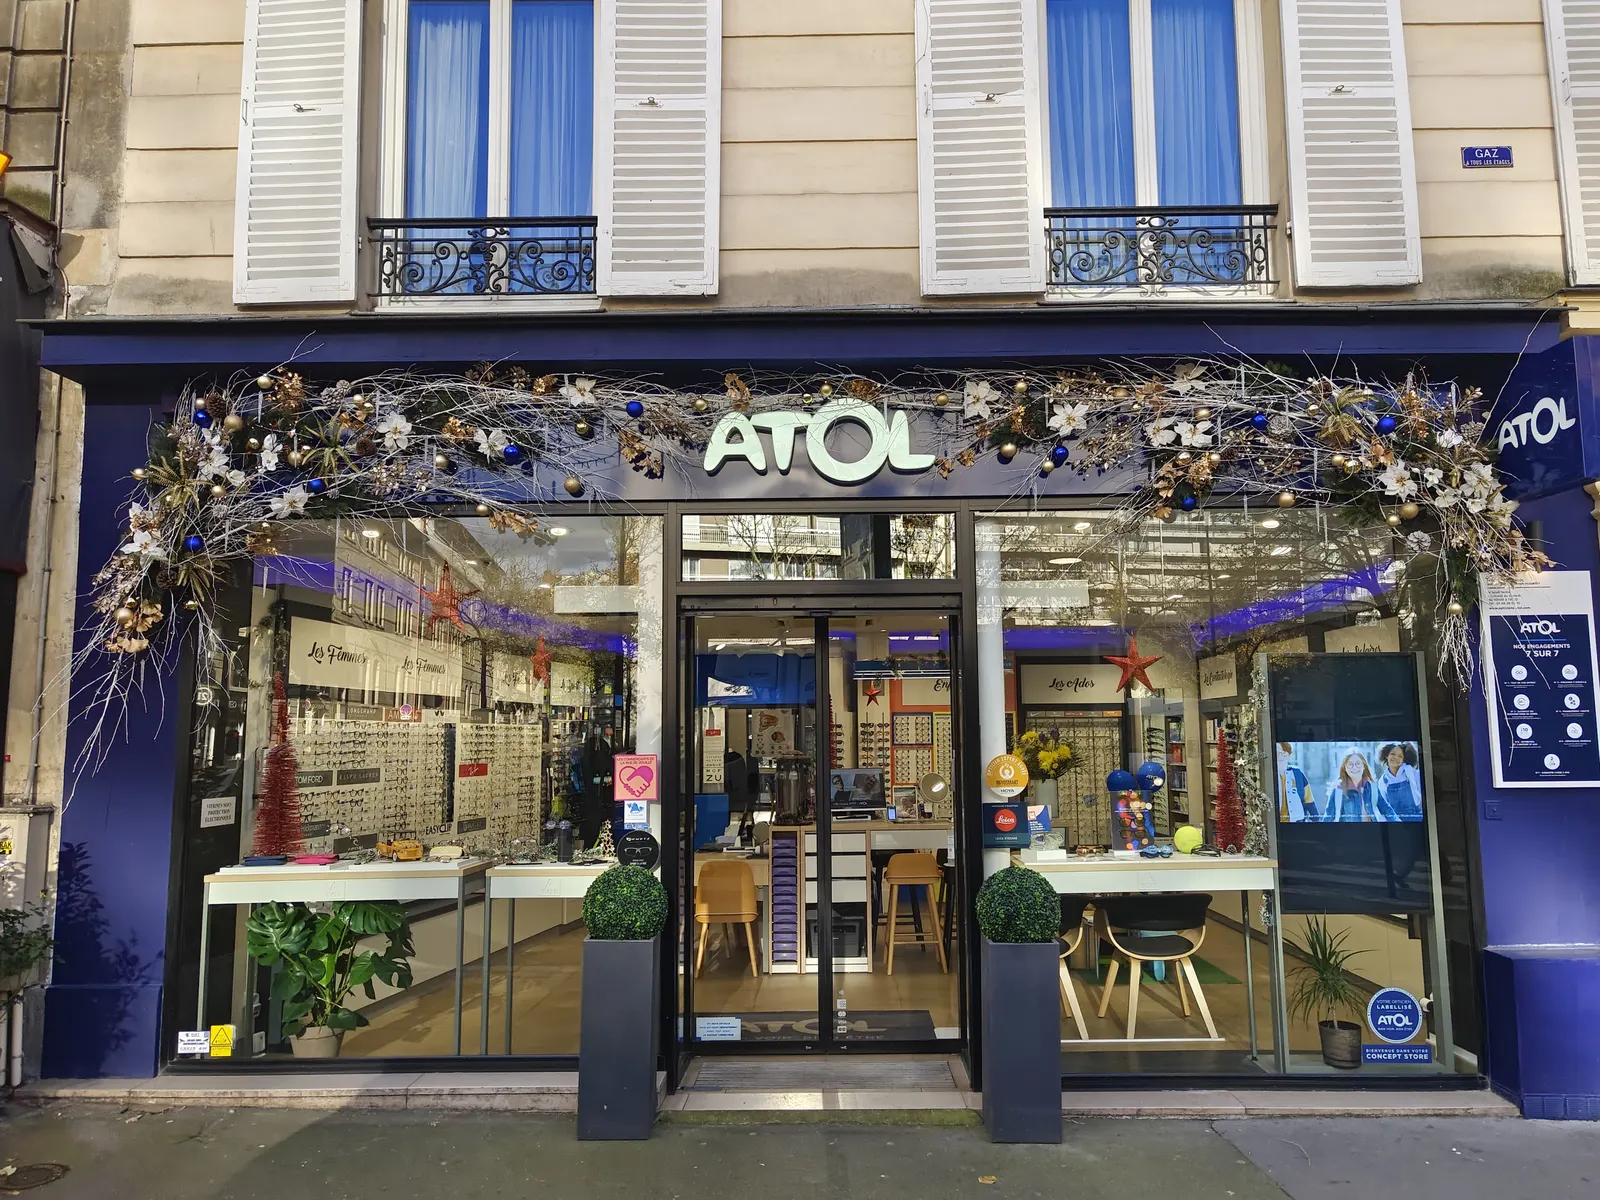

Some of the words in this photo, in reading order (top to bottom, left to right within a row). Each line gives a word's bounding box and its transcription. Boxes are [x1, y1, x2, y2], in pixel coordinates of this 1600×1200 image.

[1475, 149, 1499, 158] GAZ
[1498, 397, 1576, 454] ATOL
[703, 398, 936, 486] ATOL
[1520, 620, 1561, 635] ATOL
[307, 641, 325, 664] Les
[327, 644, 366, 665] Femmes
[401, 656, 413, 674] Les
[416, 657, 446, 675] Femmes
[1049, 678, 1065, 691] Les
[1066, 678, 1095, 692] Ados
[308, 775, 323, 784] FORD
[996, 814, 1015, 825] Leica
[1378, 1013, 1413, 1027] ATOL
